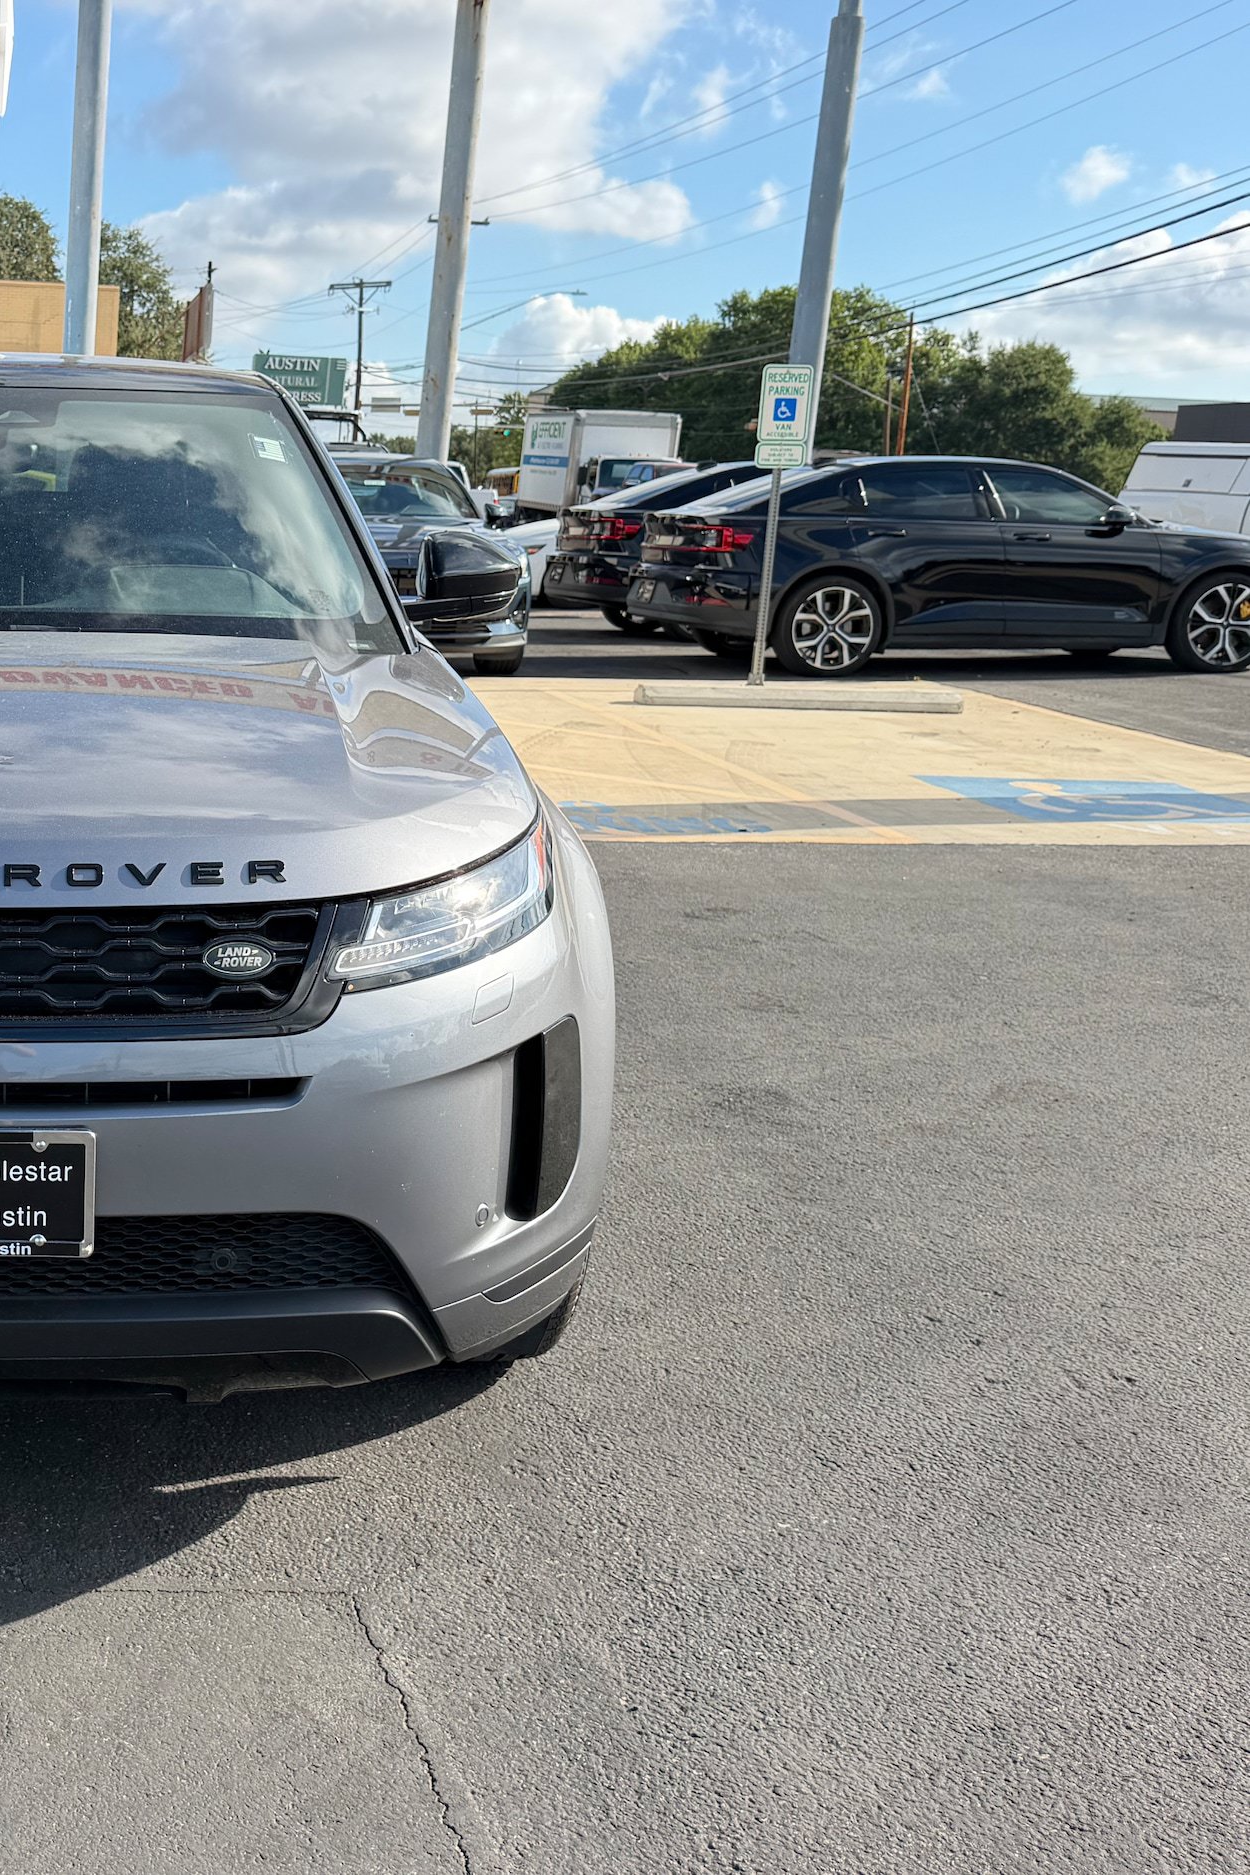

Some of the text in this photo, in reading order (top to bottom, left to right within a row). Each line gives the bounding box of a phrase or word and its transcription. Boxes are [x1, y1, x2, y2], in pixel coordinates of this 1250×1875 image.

[264, 356, 321, 372] AUSTIN
[271, 374, 318, 387] ATURAL
[768, 372, 810, 384] RESERVED
[768, 385, 805, 397] PARKING
[775, 423, 792, 431] VAN
[3, 860, 287, 888] ROVER
[217, 947, 251, 957] LAND
[221, 956, 263, 968] ROVER
